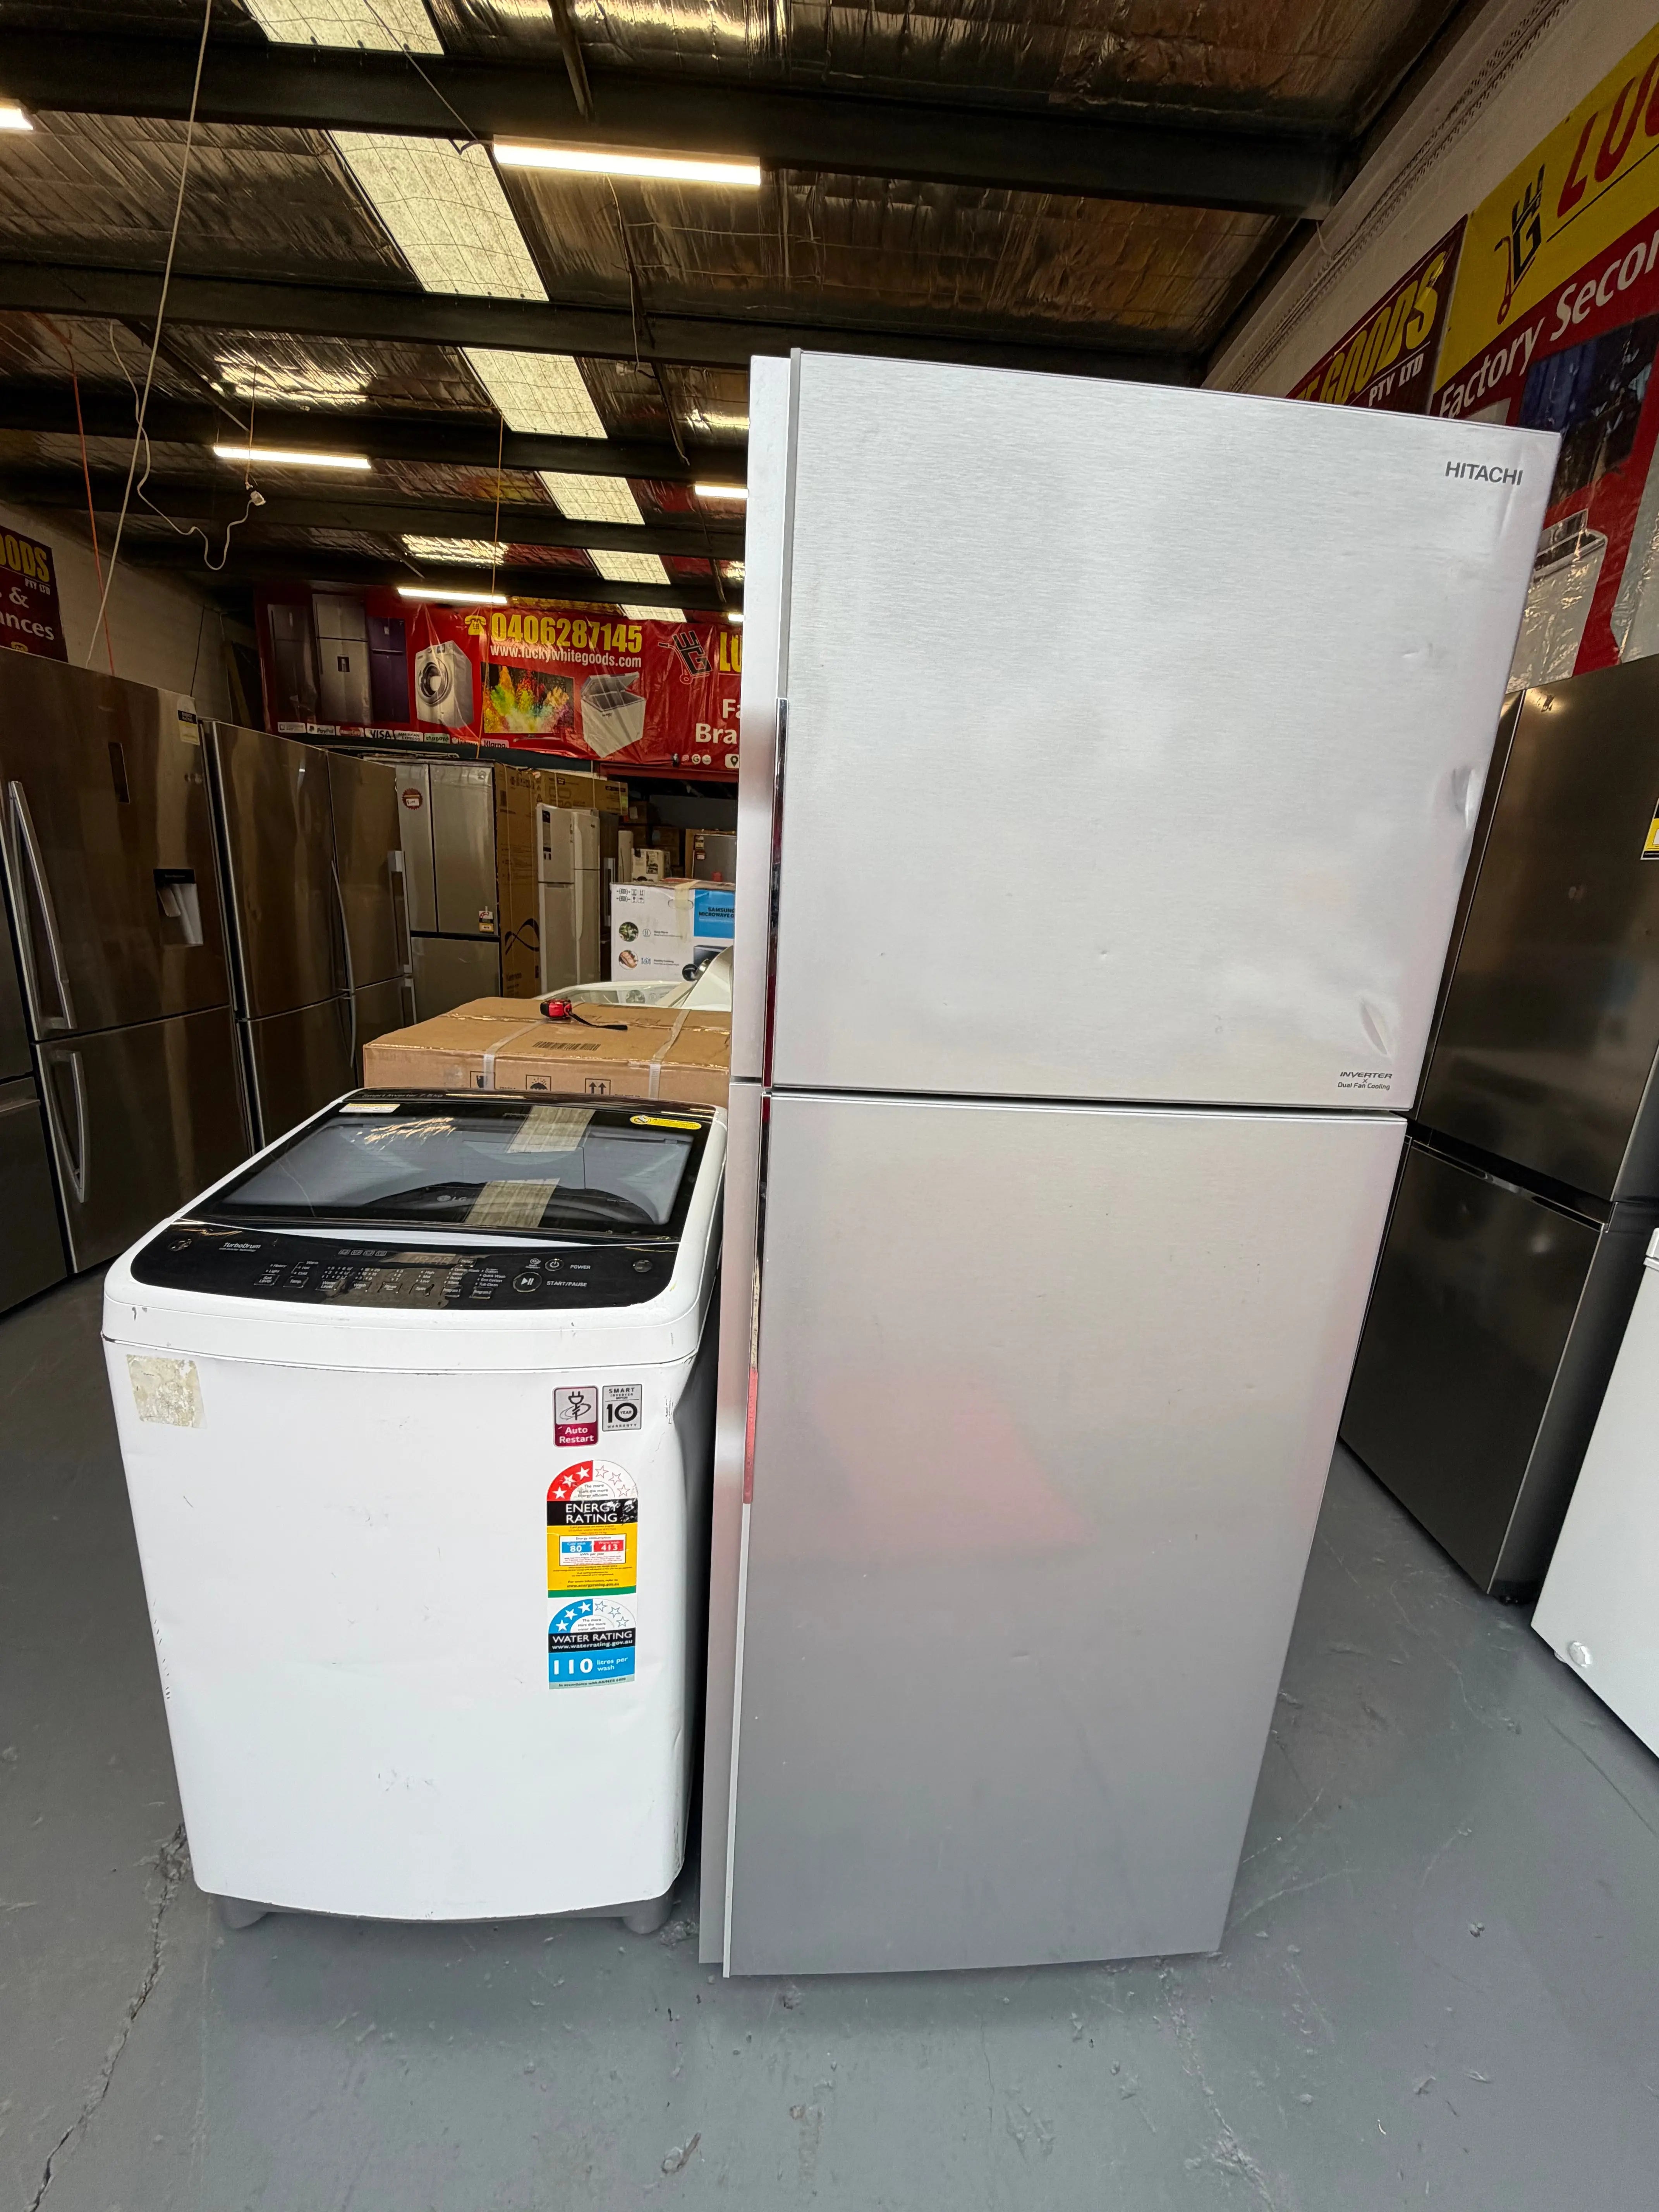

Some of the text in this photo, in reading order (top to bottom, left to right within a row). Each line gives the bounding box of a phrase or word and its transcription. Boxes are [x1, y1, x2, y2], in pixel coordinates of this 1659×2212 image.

[1439, 316, 1545, 418] Factory
[1368, 353, 1424, 407] PTY LTD
[1445, 461, 1523, 485] HITACHI
[9, 587, 29, 608] &
[491, 612, 642, 653] 0406287145
[490, 645, 641, 668] www.luckywhitegoods.com
[370, 730, 392, 739] VISA
[606, 1403, 637, 1423] 10
[559, 1435, 594, 1443] Restart
[566, 1503, 619, 1513] ENERGY
[566, 1513, 617, 1523] RATING
[552, 1631, 632, 1643] WATER RATING
[552, 1640, 633, 1650] www.waterrating.gov.au
[554, 1658, 592, 1675] 110
